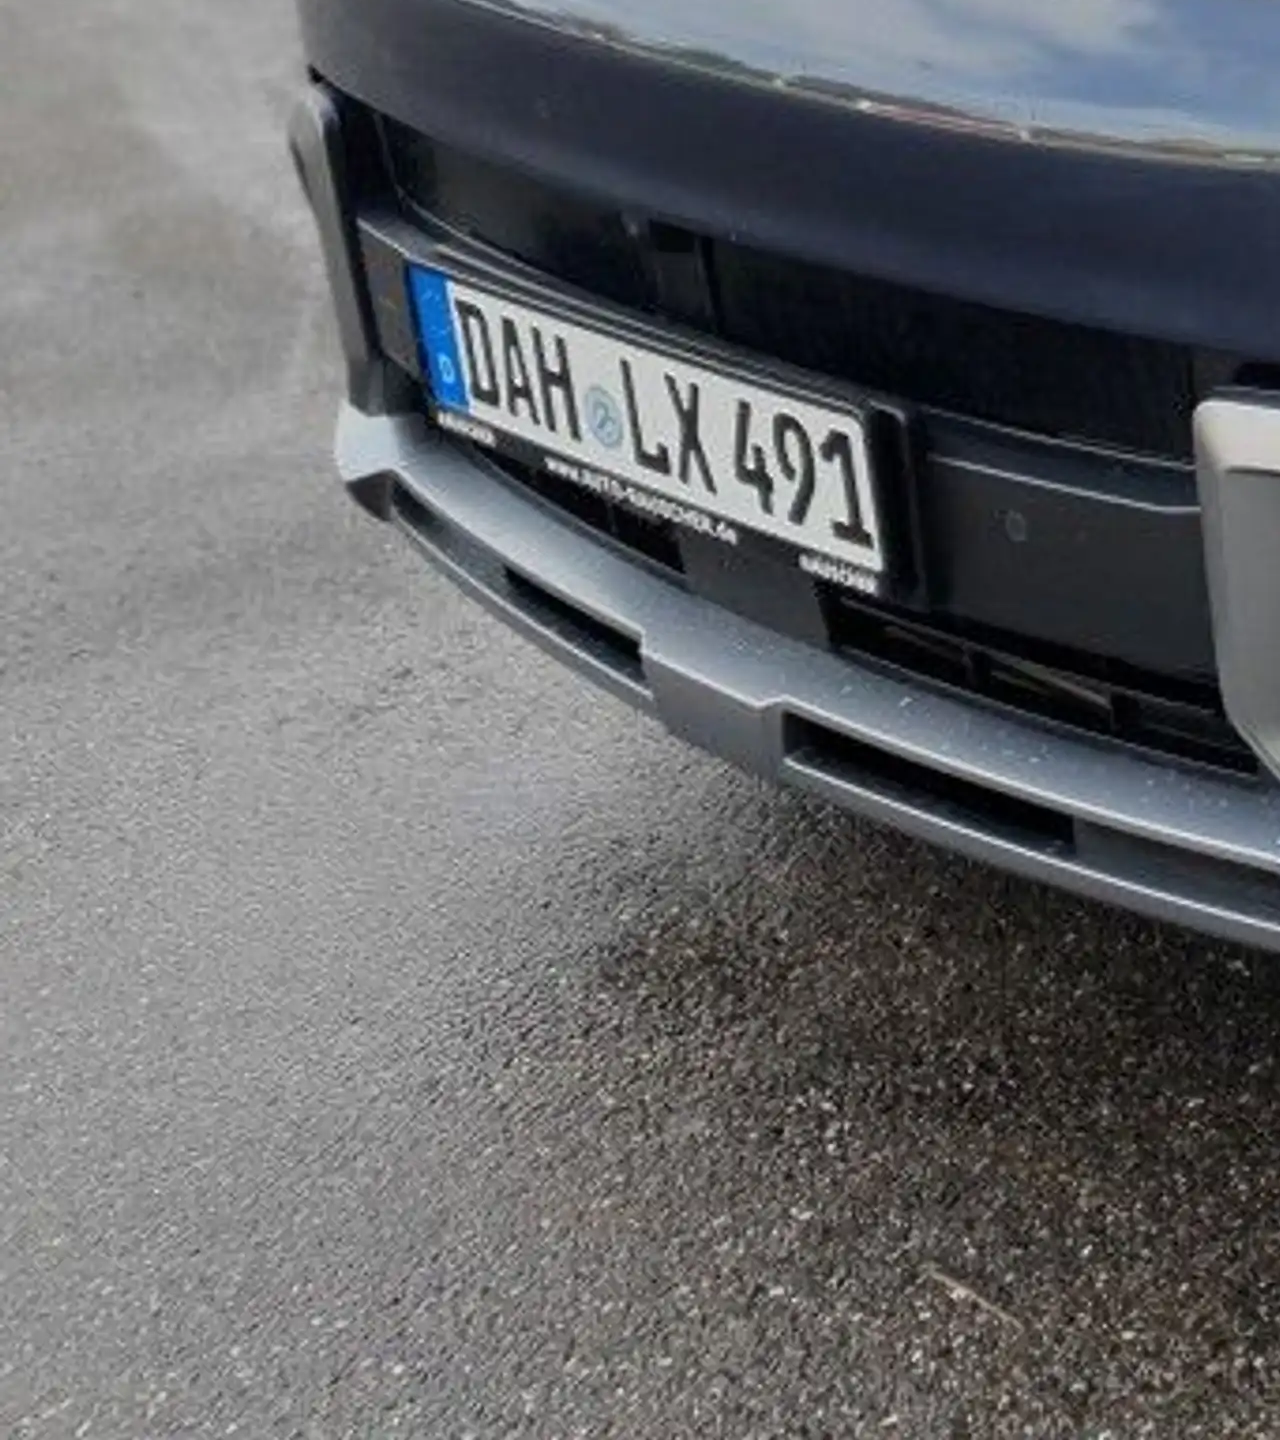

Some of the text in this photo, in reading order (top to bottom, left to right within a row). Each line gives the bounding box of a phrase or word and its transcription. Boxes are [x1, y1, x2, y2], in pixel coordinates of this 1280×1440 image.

[455, 299, 582, 443] DAH
[619, 356, 718, 496] LX
[734, 397, 876, 551] 491
